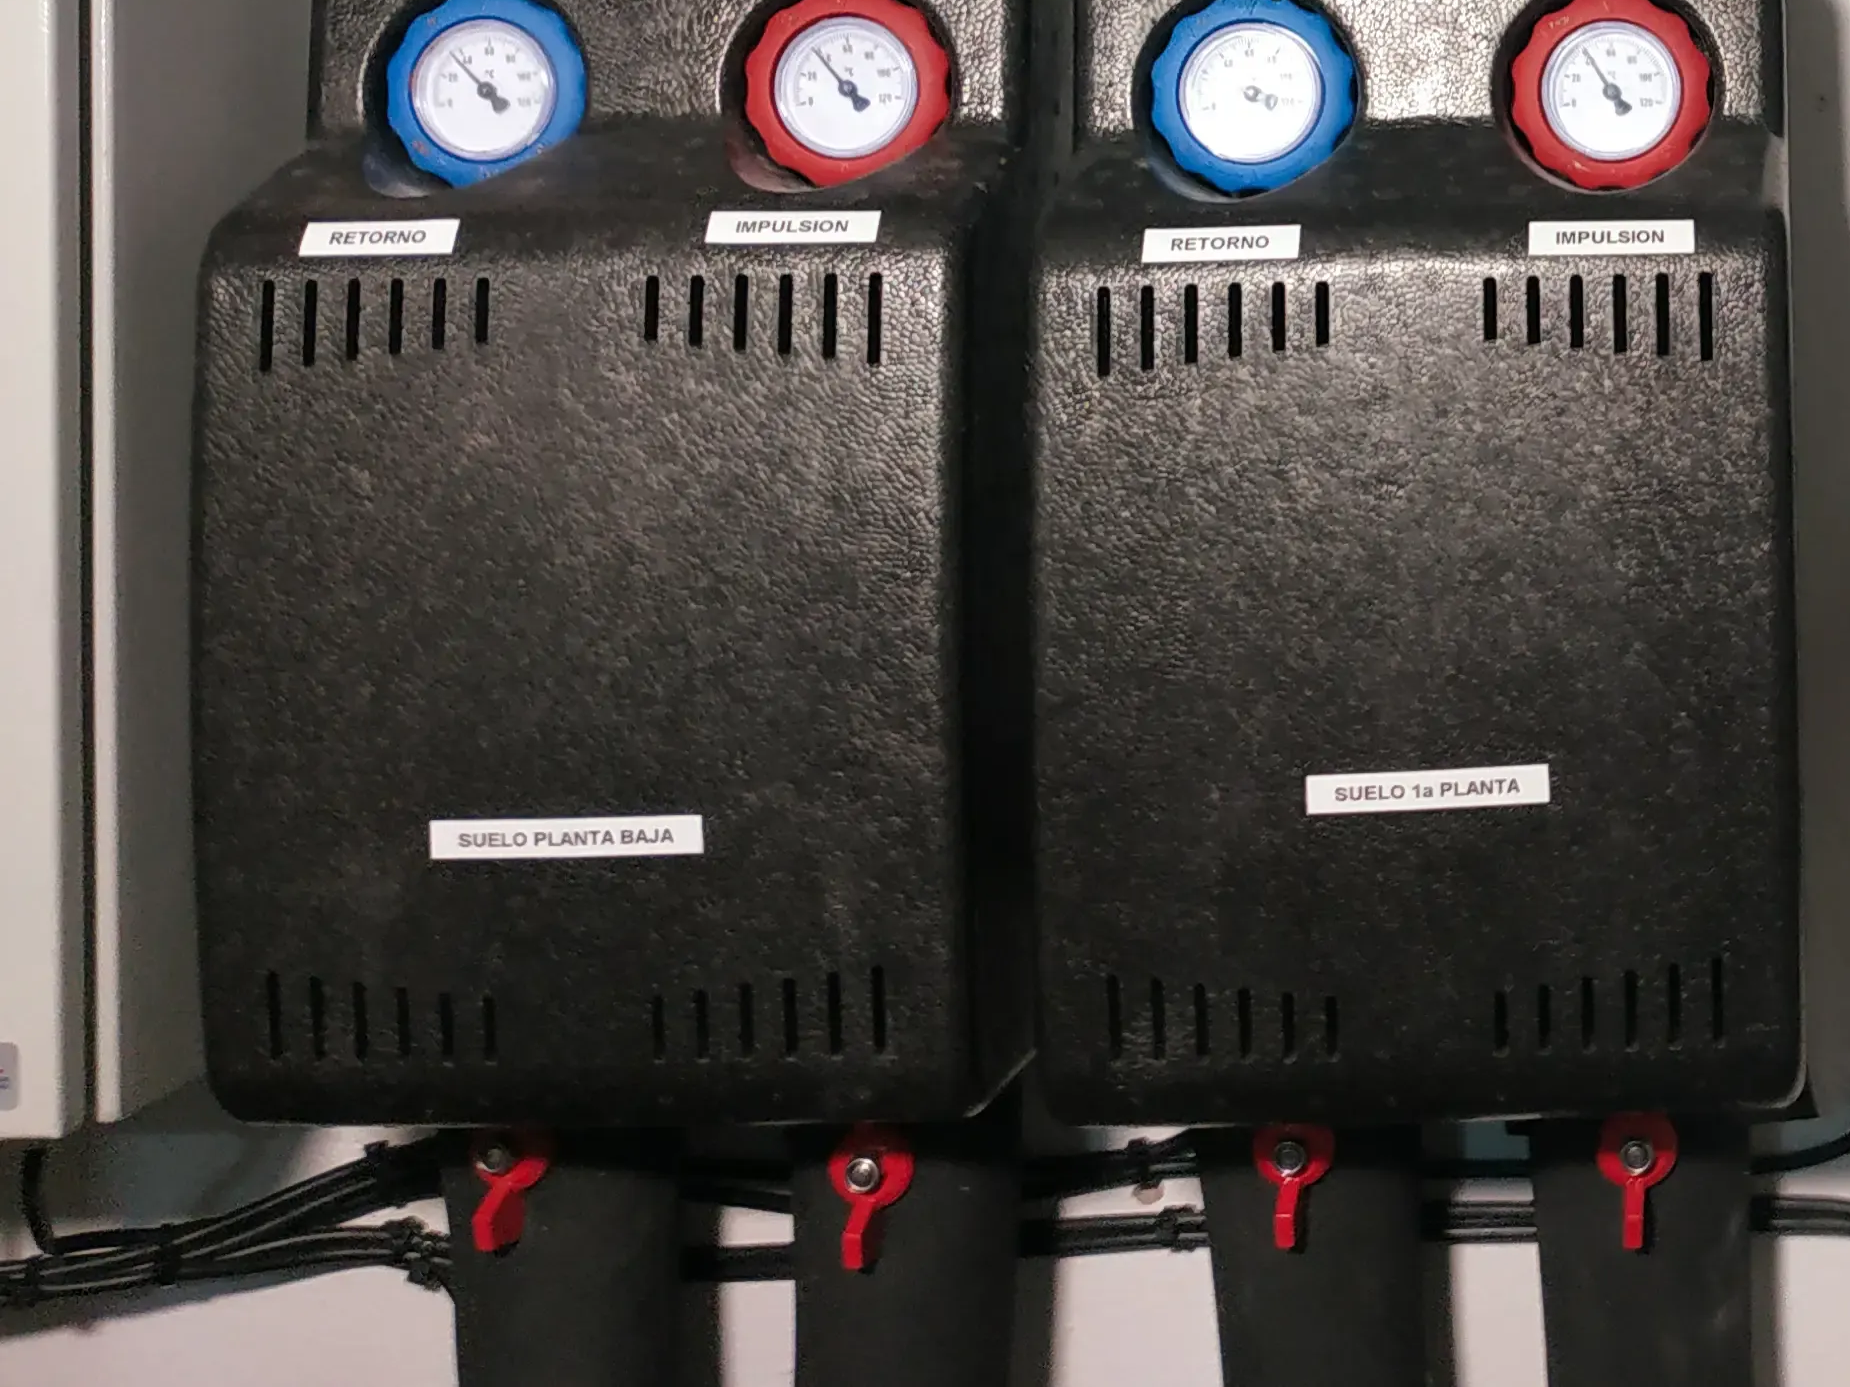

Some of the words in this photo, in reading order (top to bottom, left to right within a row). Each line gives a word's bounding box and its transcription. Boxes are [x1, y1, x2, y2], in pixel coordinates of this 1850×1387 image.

[735, 219, 849, 234] IMPULSION
[328, 229, 427, 245] RETORNO
[1170, 235, 1270, 252] RETORNO
[1555, 229, 1665, 245] IMPULSION
[1334, 784, 1406, 802] SUELO
[1412, 784, 1434, 798] 1a
[1440, 778, 1521, 797] PLANTA
[458, 832, 528, 848] SUELO
[533, 829, 613, 847] PLANTA
[619, 827, 675, 845] BAJA
